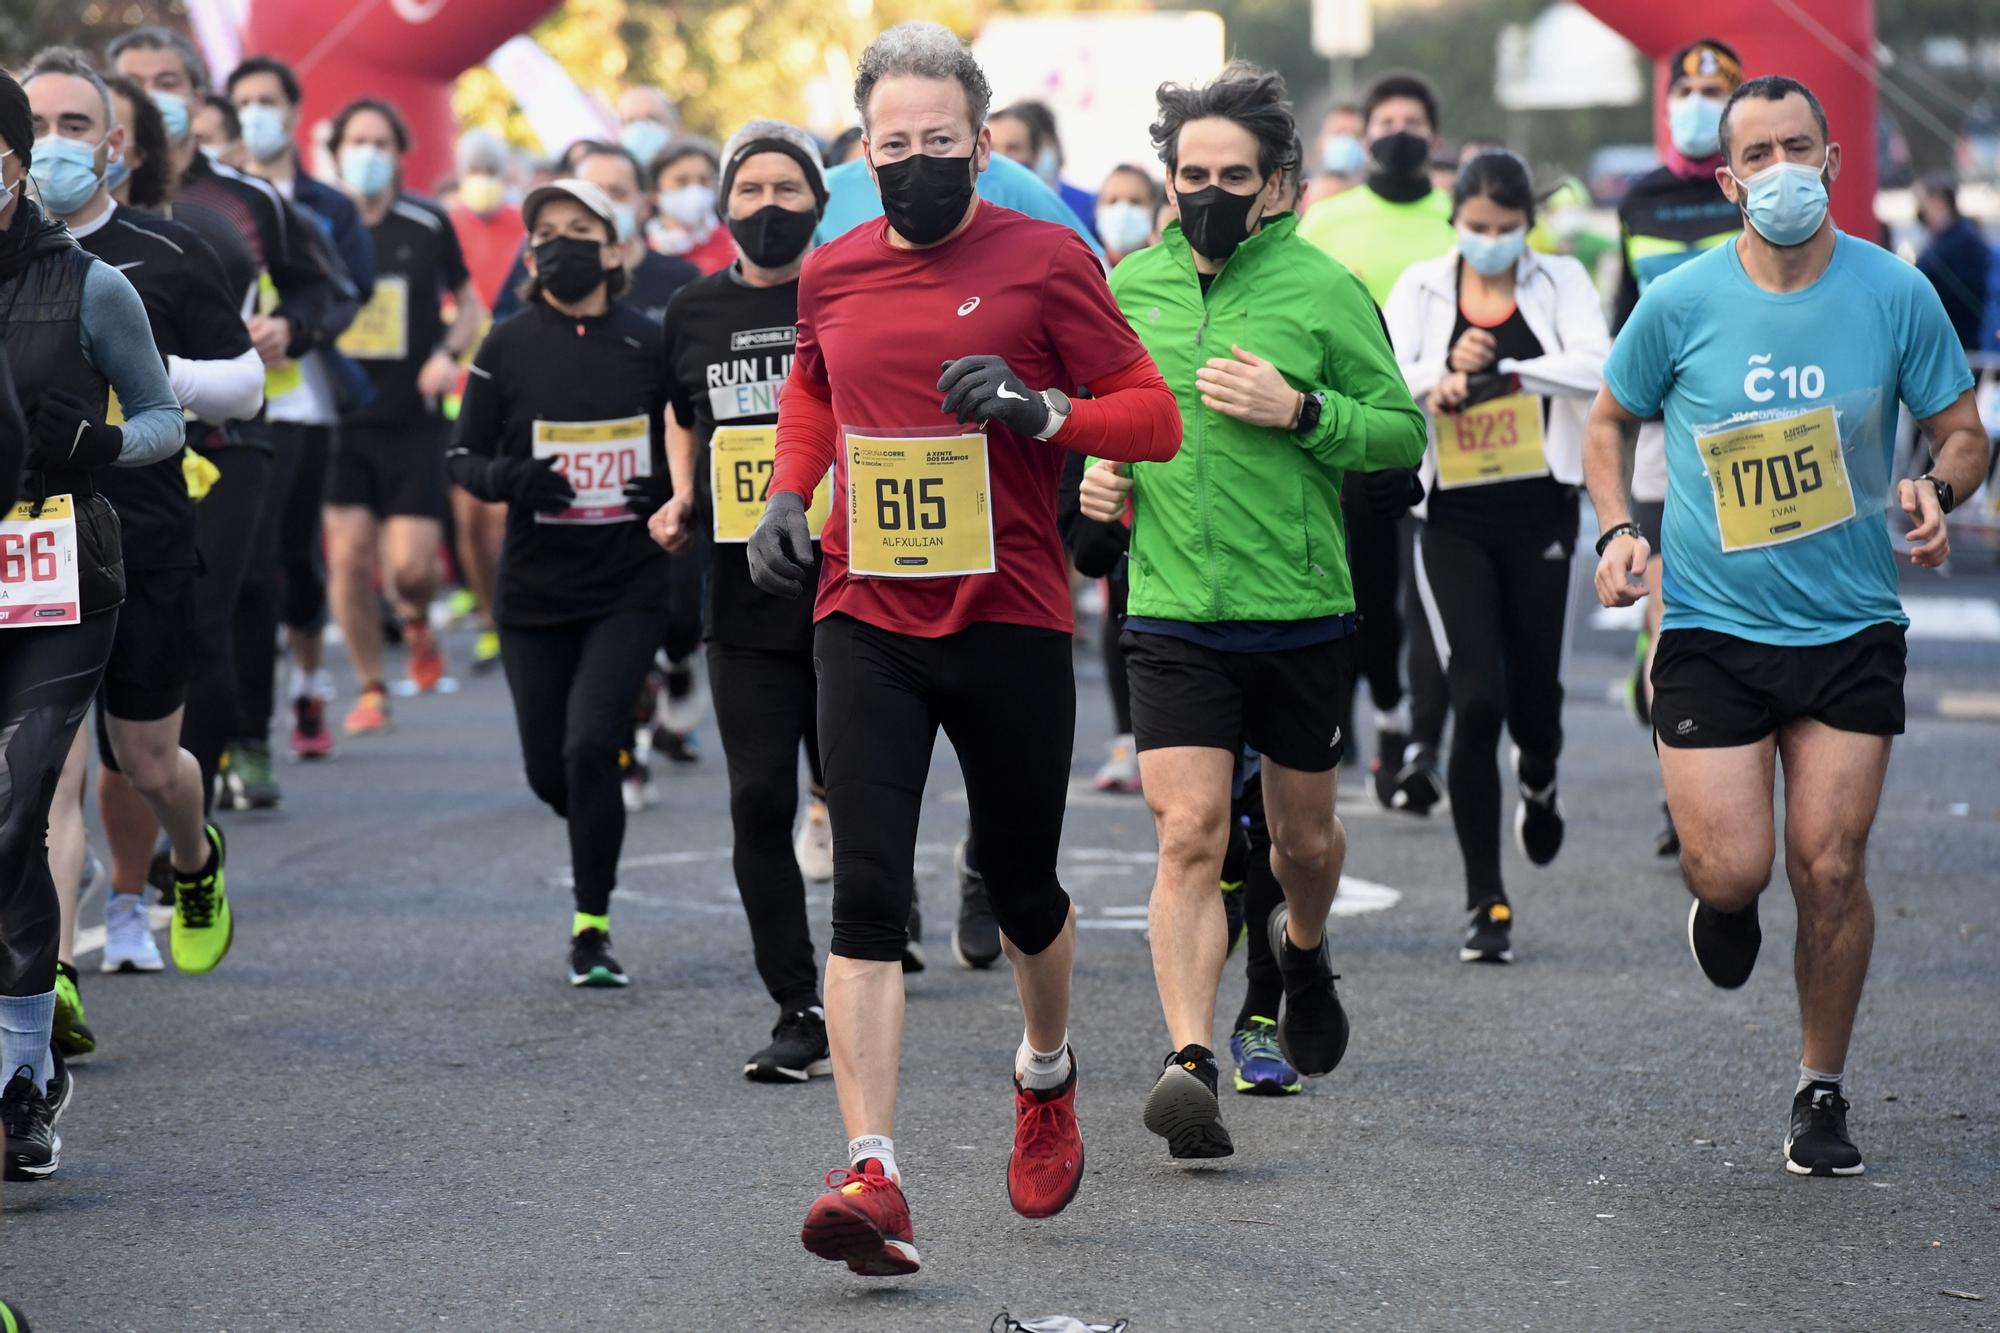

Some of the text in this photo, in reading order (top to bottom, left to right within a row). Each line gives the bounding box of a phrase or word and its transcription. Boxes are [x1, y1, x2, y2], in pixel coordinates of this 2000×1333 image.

[706, 357, 758, 388] RUN
[1779, 365, 1825, 400] 10
[1454, 409, 1519, 454] 623
[1731, 445, 1822, 507] 1705
[875, 477, 947, 531] 615
[1771, 504, 1797, 518] IVAN
